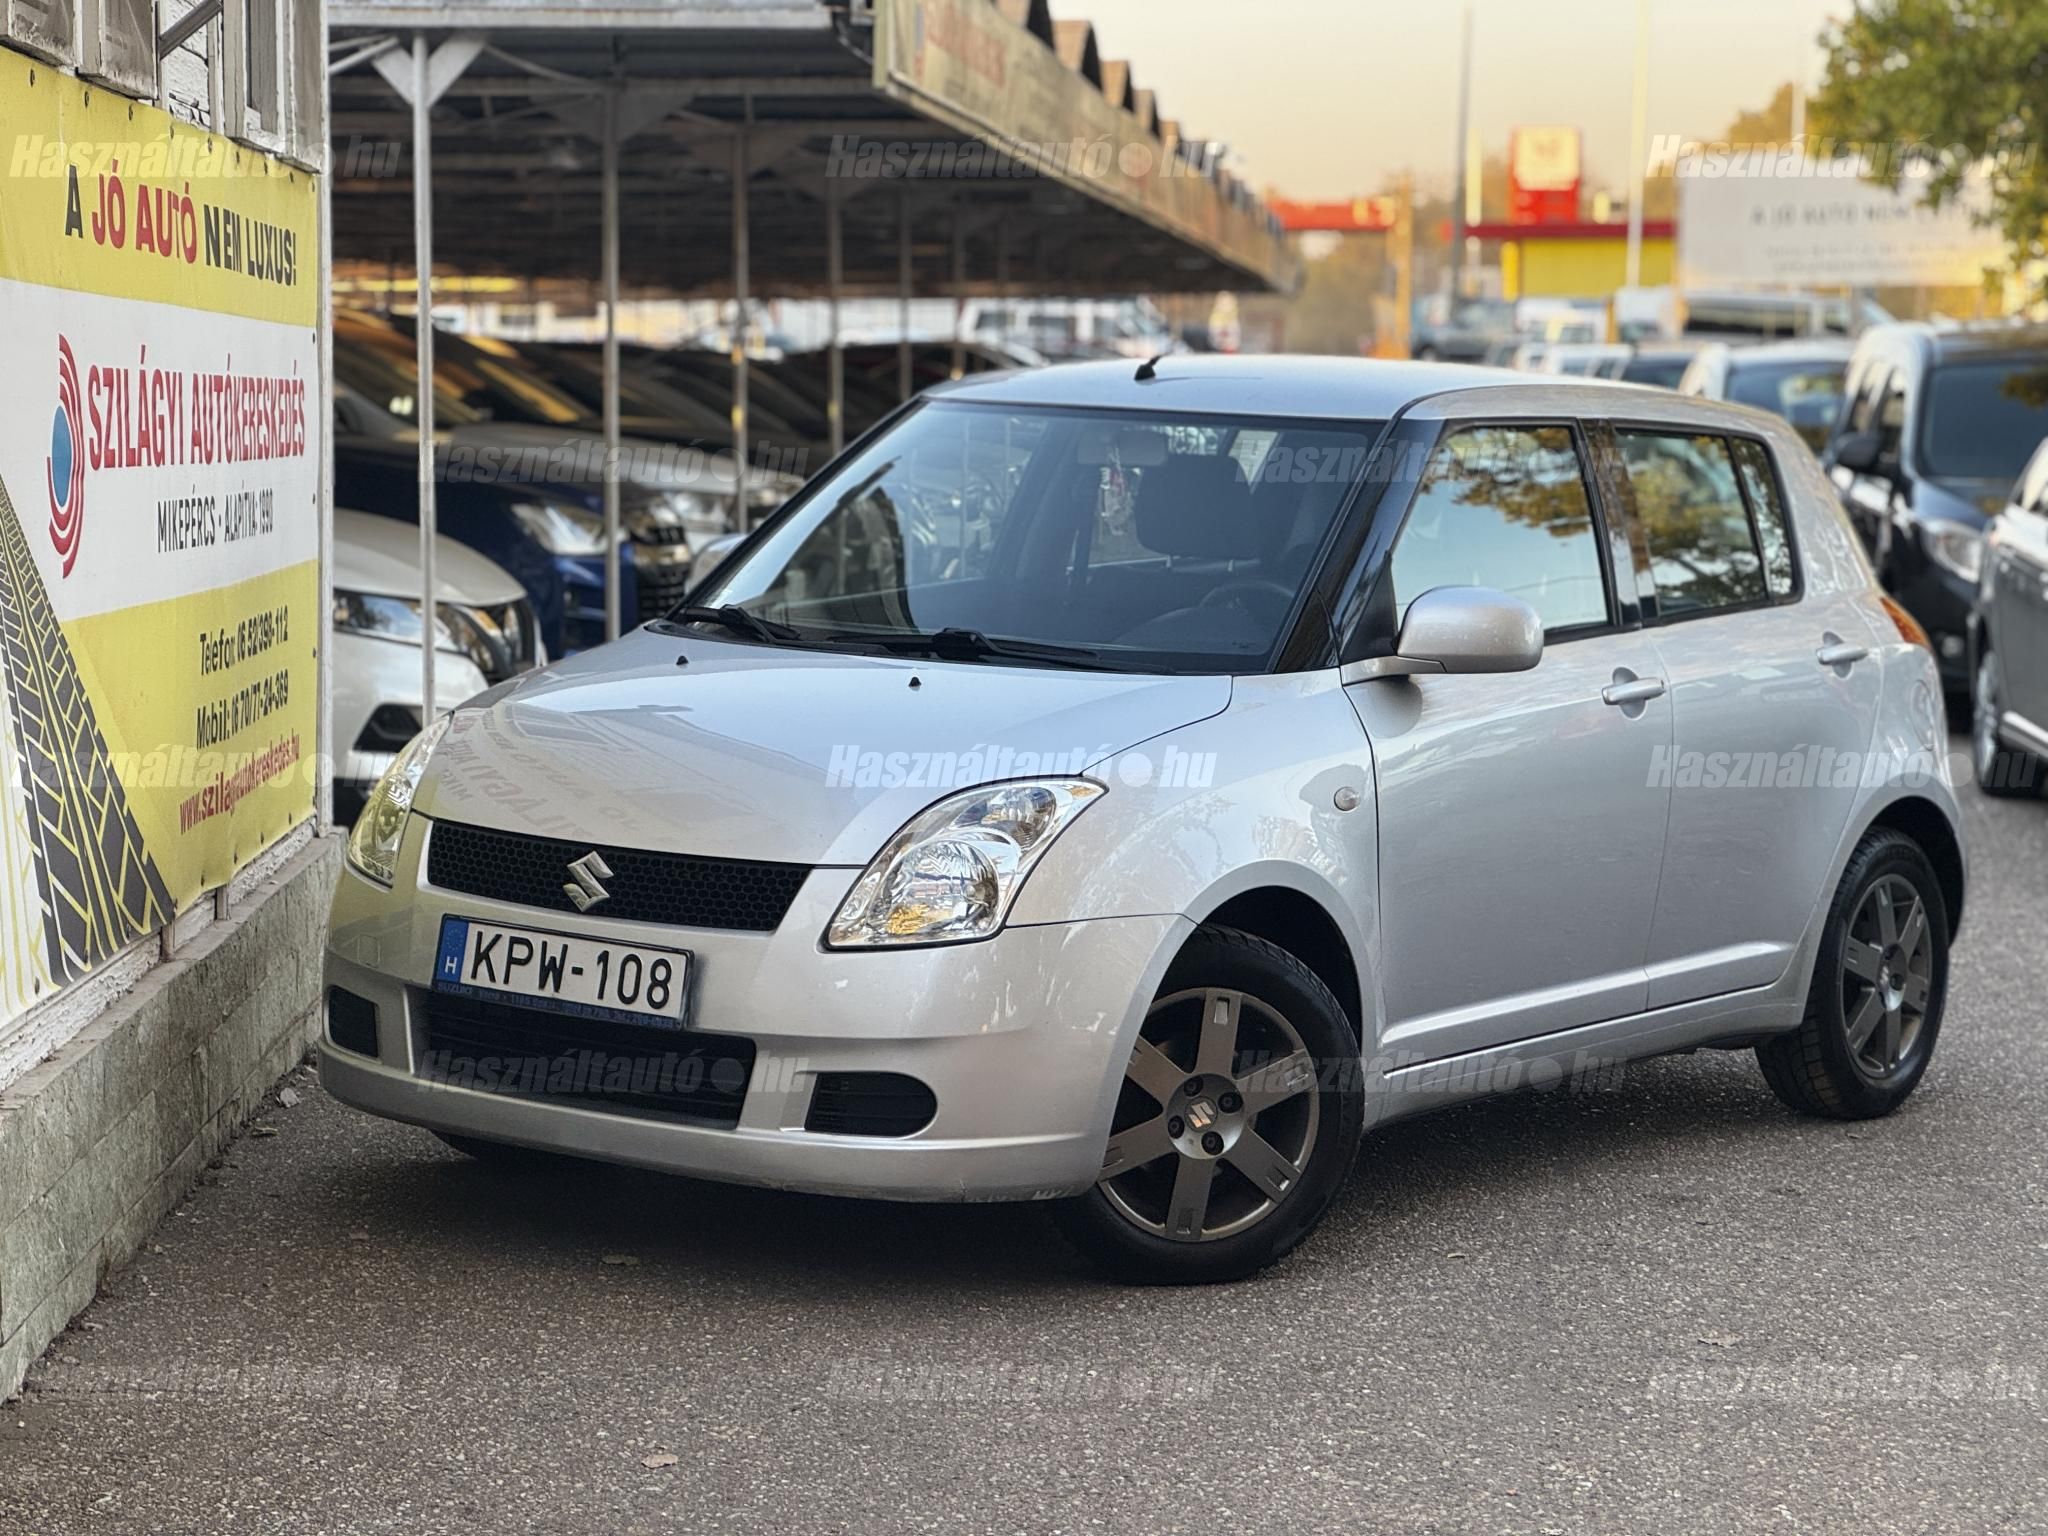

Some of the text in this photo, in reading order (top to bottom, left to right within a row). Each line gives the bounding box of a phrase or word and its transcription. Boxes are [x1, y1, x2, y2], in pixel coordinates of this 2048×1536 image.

[65, 158, 297, 286] A JÓ AUTÓ NEM LUXUS!
[88, 344, 305, 471] SZILÁGYI AUTÓKERESKEDÉS
[157, 483, 216, 553] MIKEPÉRCS
[224, 480, 258, 543] ALAPÍTVA:
[196, 699, 230, 752] Mobil:
[443, 954, 458, 976] H
[469, 929, 674, 1011] KPW-108
